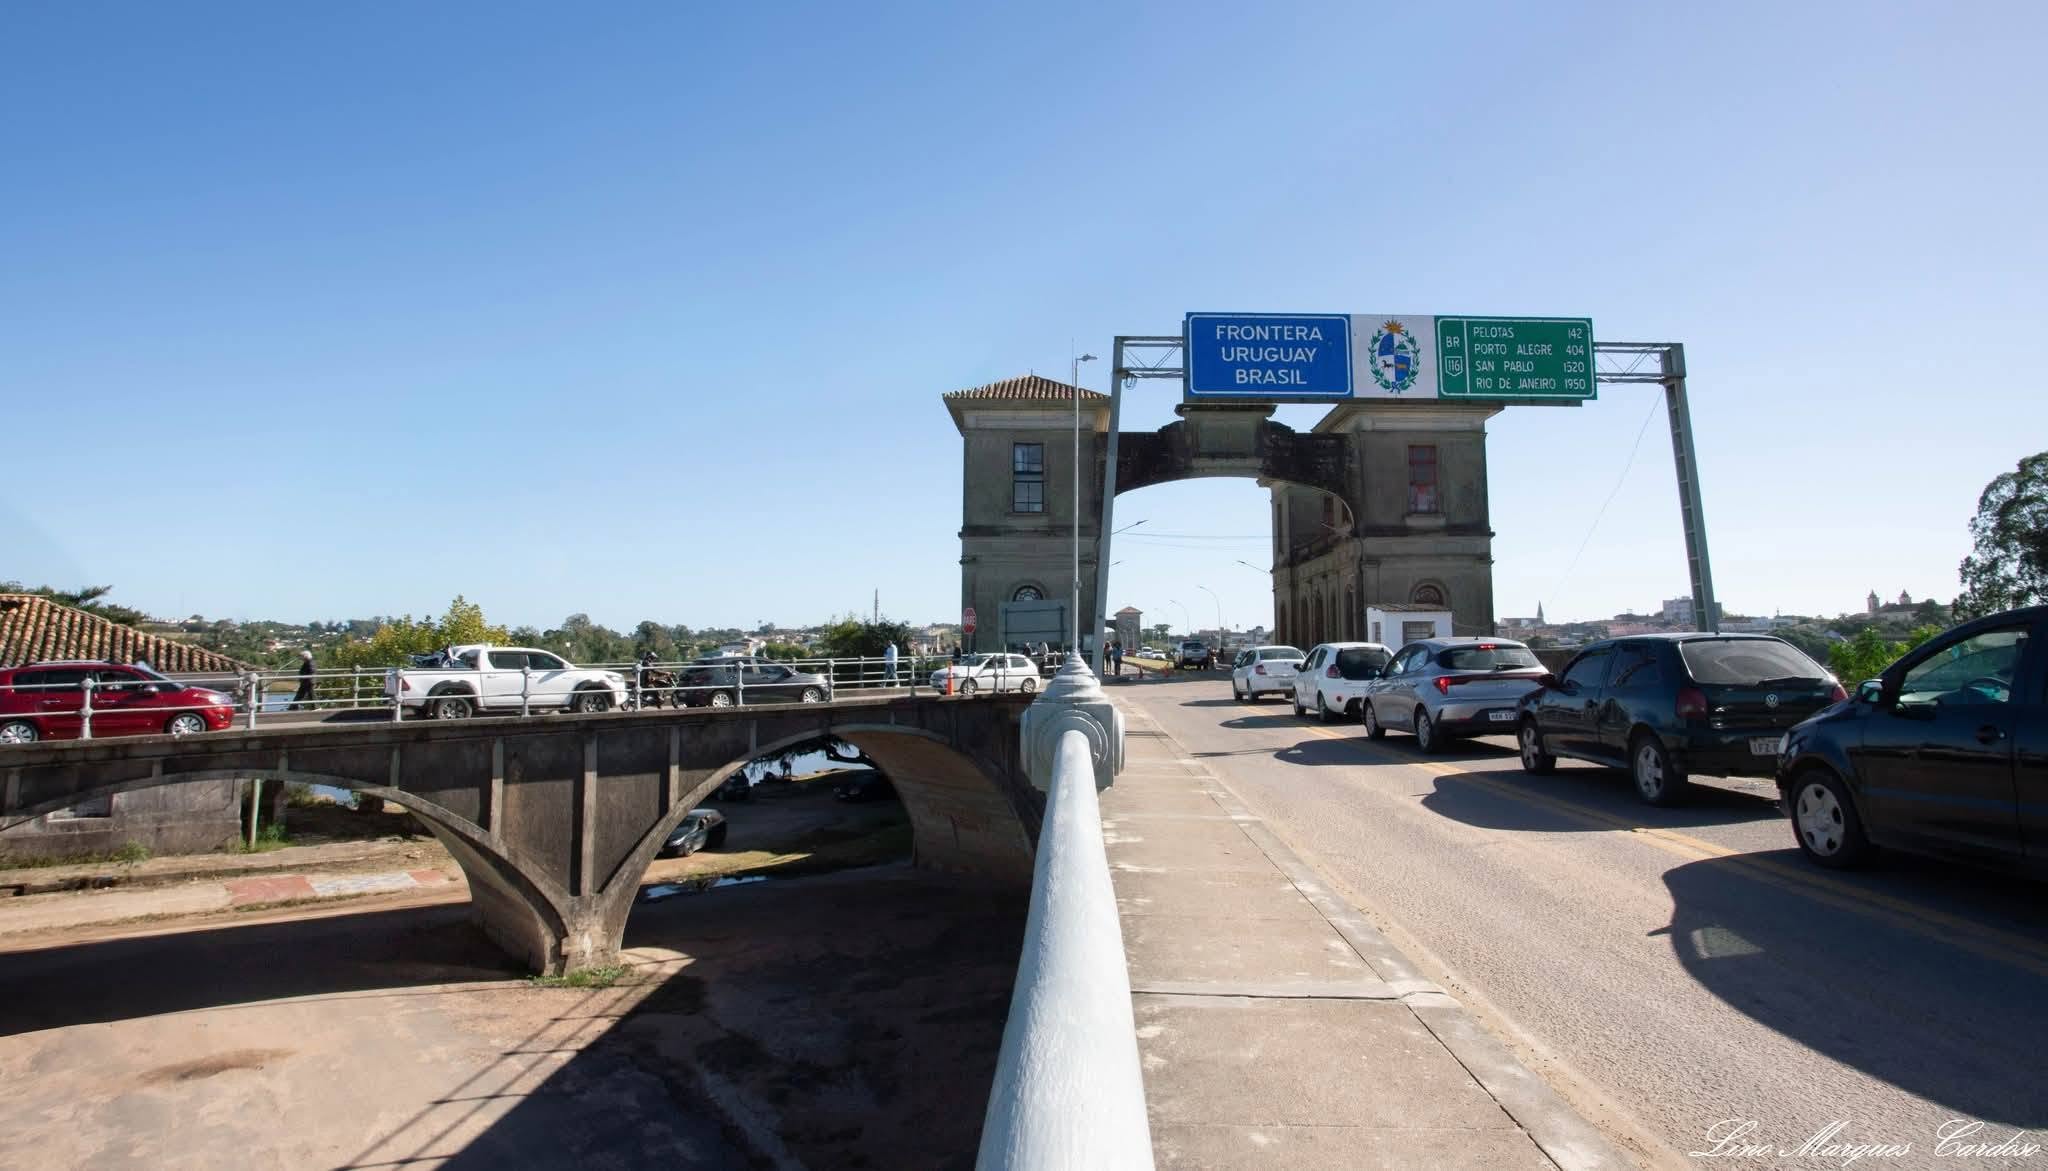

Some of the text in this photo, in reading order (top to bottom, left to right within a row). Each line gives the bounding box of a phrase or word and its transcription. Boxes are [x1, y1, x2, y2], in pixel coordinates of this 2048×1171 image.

[1216, 325, 1323, 341] FRONTERA
[1473, 326, 1583, 339] PELOTAS 142
[1446, 336, 1460, 348] BR
[1221, 347, 1317, 362] URUGUAY
[1474, 343, 1585, 356] PORTO ALEGRE 404
[1448, 359, 1460, 372] 116
[1475, 361, 1585, 373] SAN PABLO 1520
[1236, 369, 1307, 385] BRASIL
[1476, 377, 1586, 390] RIO DE JANEIRO 1950
